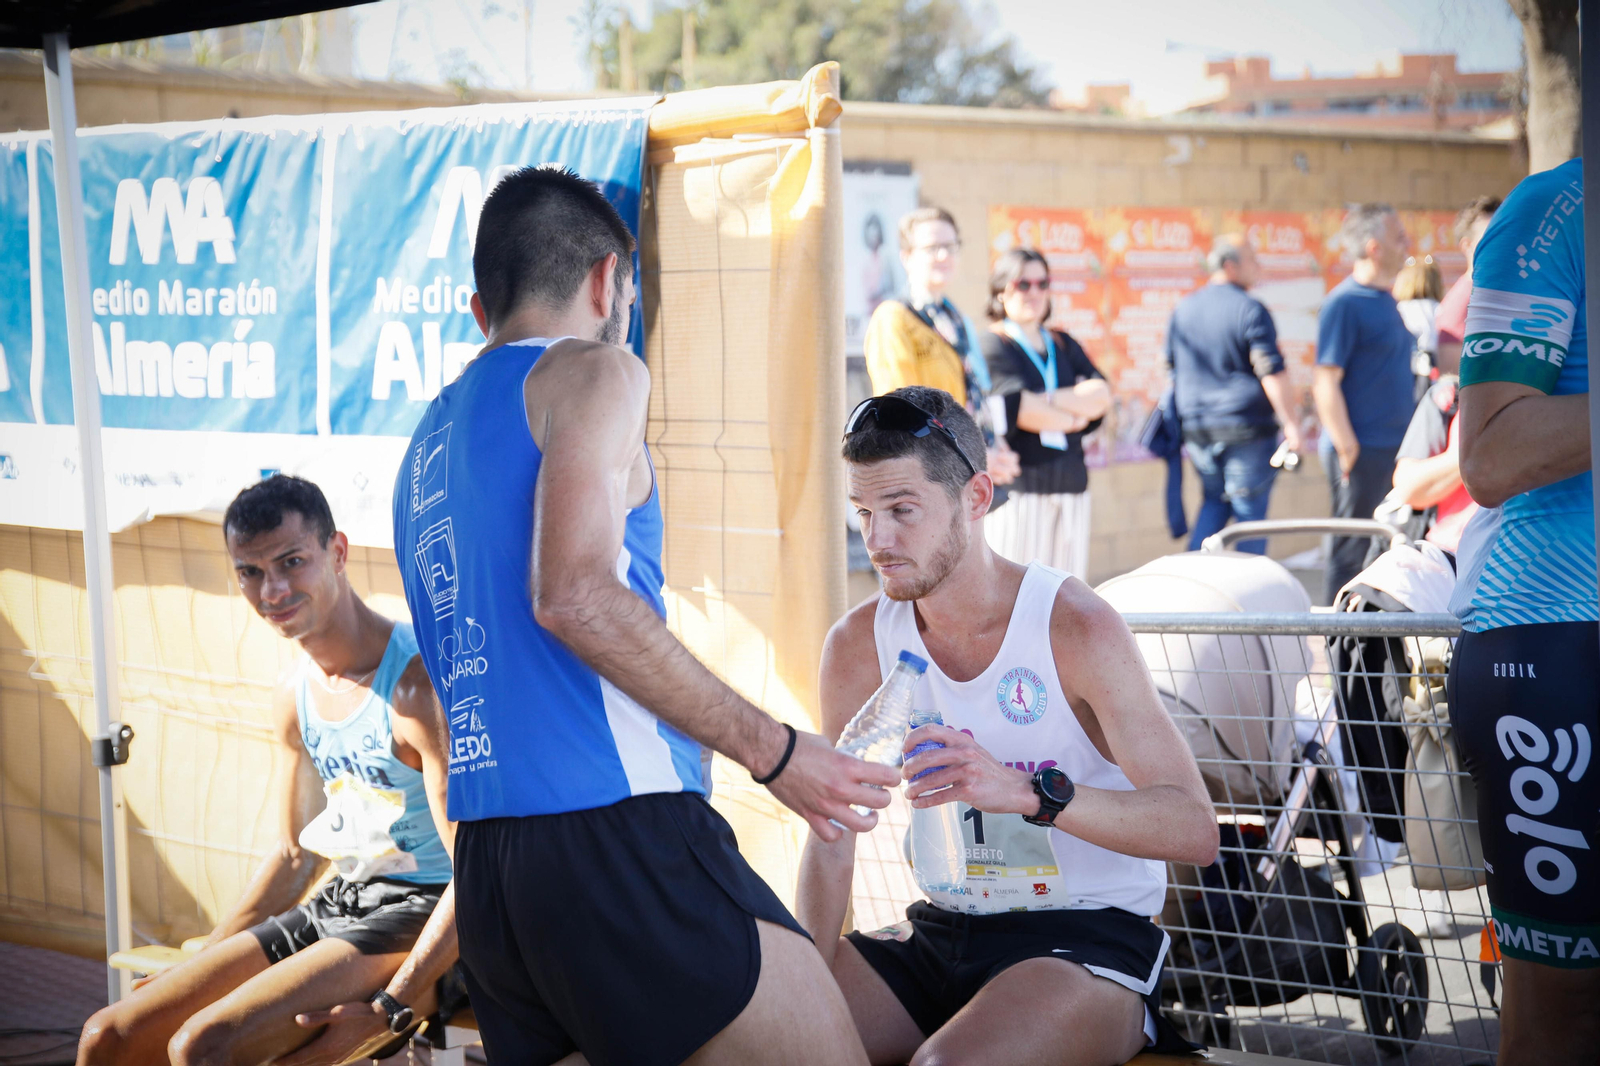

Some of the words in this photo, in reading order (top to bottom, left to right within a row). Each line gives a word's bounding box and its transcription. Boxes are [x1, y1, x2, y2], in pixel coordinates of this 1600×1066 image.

[1531, 181, 1584, 254] RETELI
[92, 279, 150, 316] edio
[158, 278, 277, 316] Maratón
[373, 276, 474, 314] Medio
[1461, 338, 1567, 368] KOME
[413, 446, 423, 513] natural
[431, 562, 454, 587] FL
[441, 656, 489, 692] MARIO
[998, 682, 1007, 695] GO
[1003, 668, 1042, 688] TRAINING
[1493, 663, 1536, 678] GOBIK
[999, 700, 1035, 724] RUNNING
[1034, 692, 1047, 716] CLUB
[964, 806, 985, 844] 1
[1492, 917, 1600, 959] OMETA
